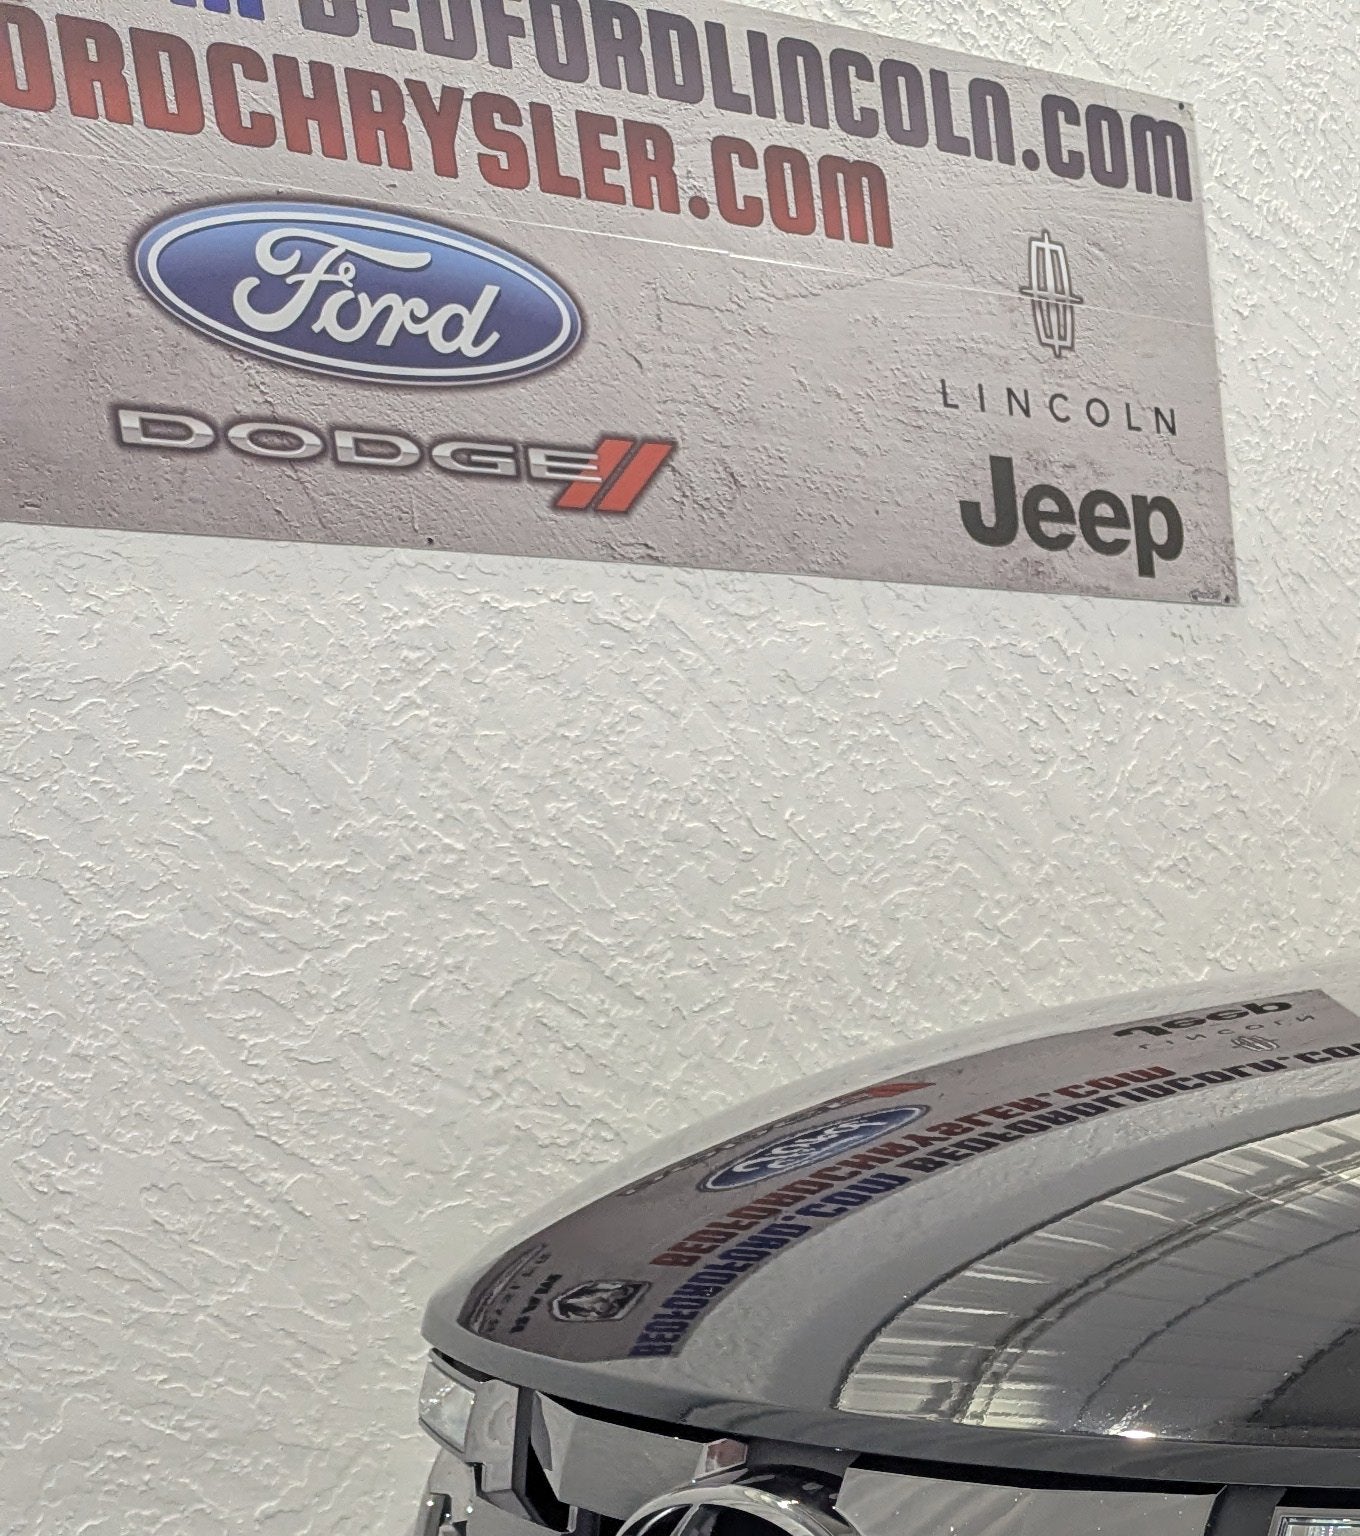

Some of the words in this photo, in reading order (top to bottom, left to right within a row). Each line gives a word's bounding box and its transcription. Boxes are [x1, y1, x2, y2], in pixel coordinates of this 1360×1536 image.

[232, 227, 502, 358] Ford
[117, 407, 603, 484] DODGE
[939, 378, 1177, 436] LINCOLN
[959, 454, 1185, 578] Jeep
